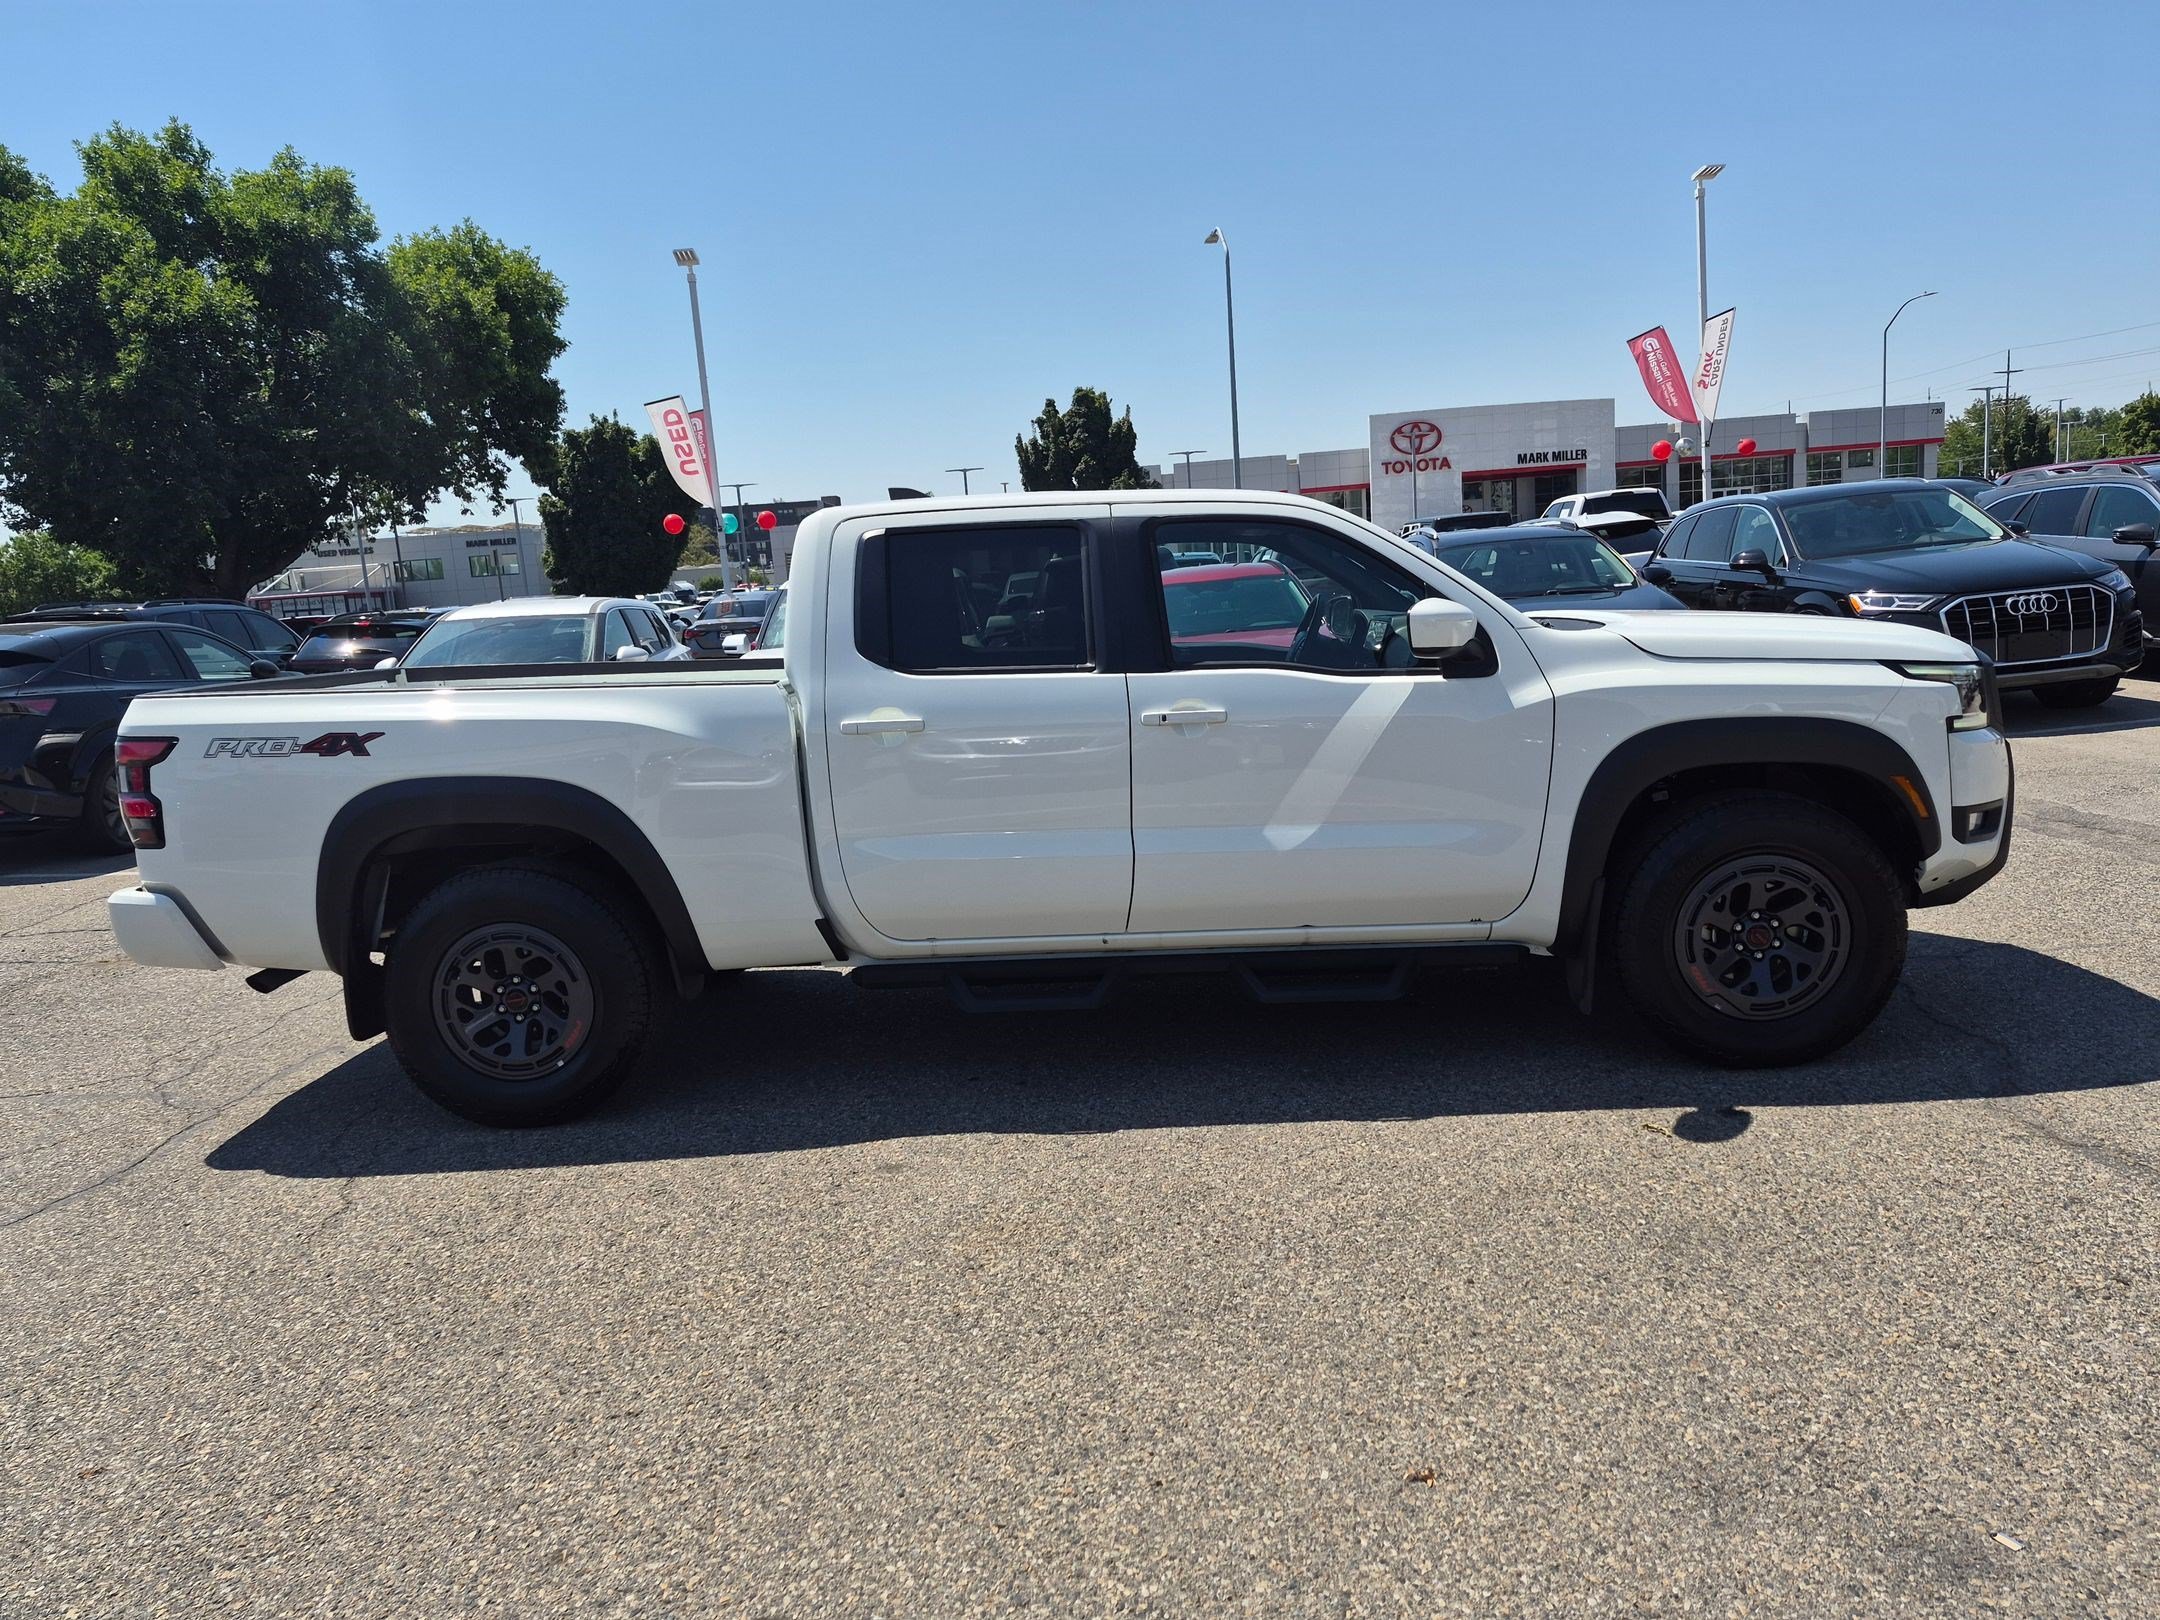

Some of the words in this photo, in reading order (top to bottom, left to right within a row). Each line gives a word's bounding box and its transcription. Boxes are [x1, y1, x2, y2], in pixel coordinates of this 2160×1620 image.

[1655, 349, 1664, 362] Ken
[1646, 351, 1663, 383] Nissan
[1930, 407, 1943, 415] 730
[1517, 451, 1549, 465] MARK
[1552, 448, 1588, 462] MILLER
[1381, 456, 1451, 475] TOYOTA
[465, 539, 489, 548] MARK
[490, 537, 517, 546] MILLER
[338, 546, 374, 556] VEHICES
[204, 731, 386, 759] PRO-4X
